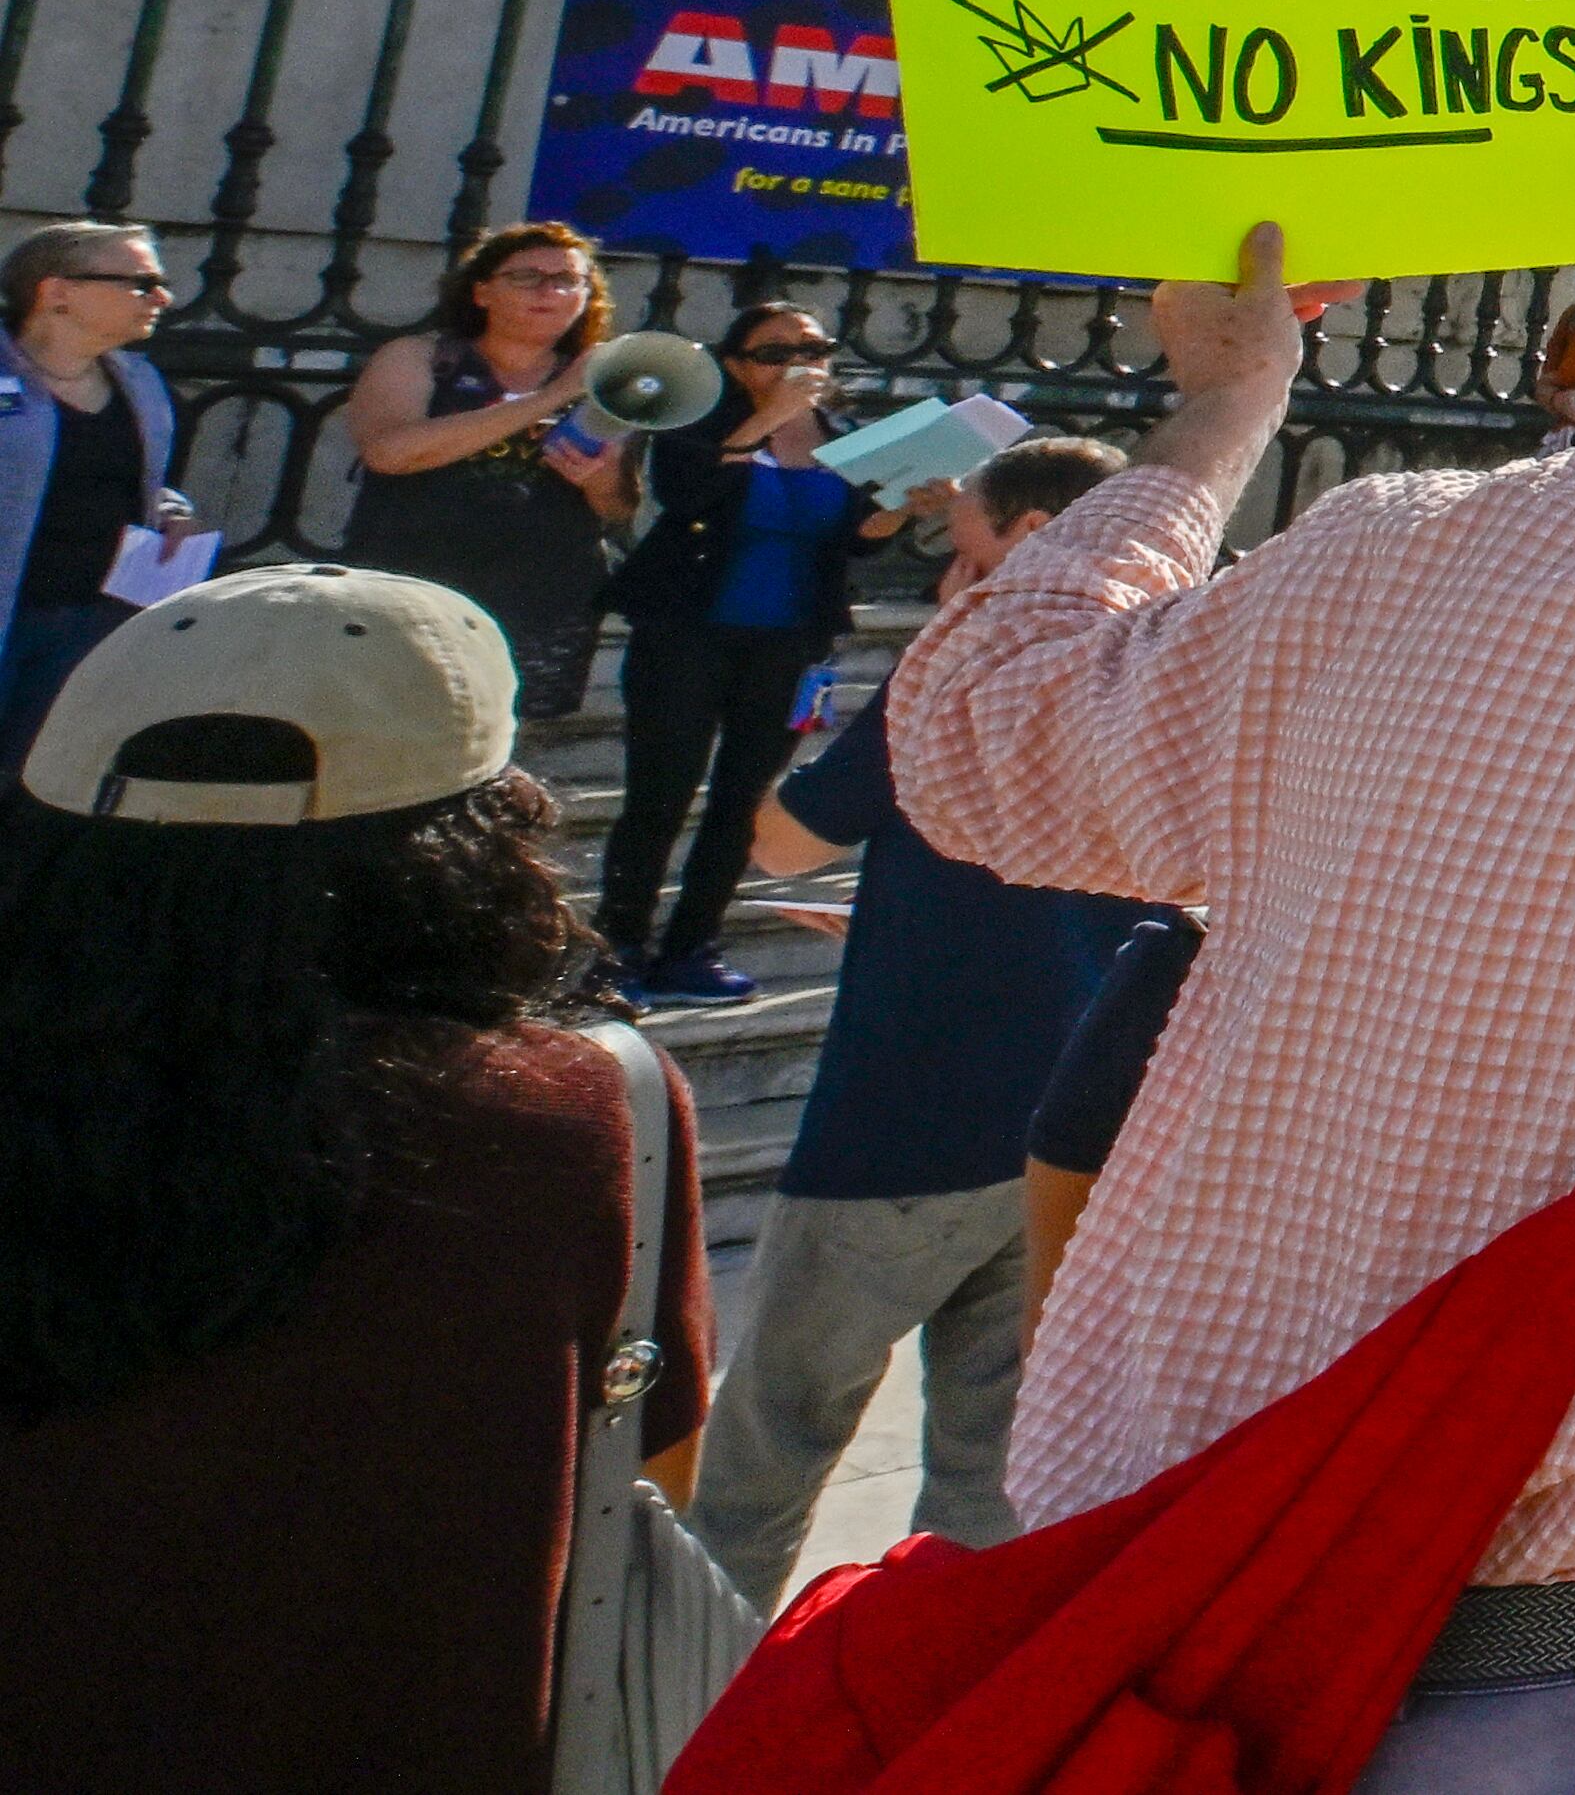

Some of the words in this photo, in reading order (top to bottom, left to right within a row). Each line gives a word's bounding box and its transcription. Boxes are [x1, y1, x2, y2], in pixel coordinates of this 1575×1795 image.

[1156, 23, 1297, 124] NO
[627, 106, 830, 148] Americans
[839, 128, 877, 153] in
[734, 166, 783, 193] for
[791, 178, 812, 194] a
[820, 180, 889, 201] sane
